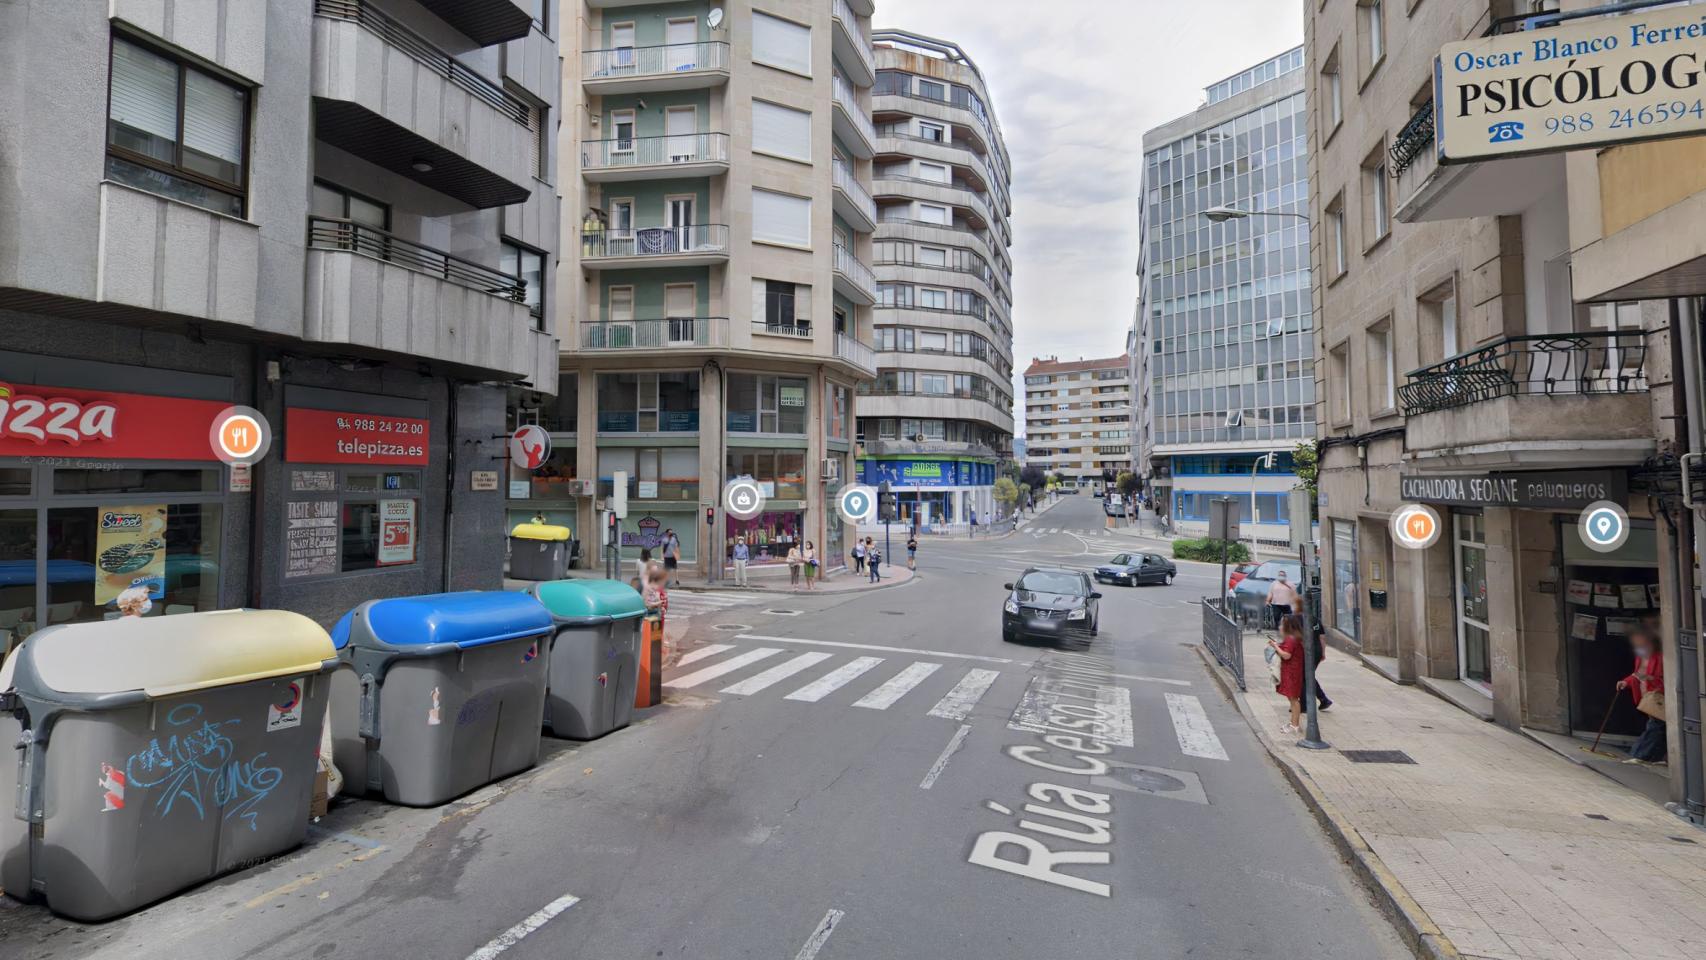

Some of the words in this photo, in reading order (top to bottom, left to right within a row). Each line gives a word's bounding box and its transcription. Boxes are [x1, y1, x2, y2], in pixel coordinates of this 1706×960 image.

[1454, 50, 1523, 72] Oscar
[1532, 35, 1618, 62] Blanco
[1456, 52, 1706, 118] PSICÓLOG
[1545, 113, 1594, 136] 988
[1609, 98, 1705, 129] 246594
[354, 419, 375, 431] 988
[379, 421, 392, 432] 24
[395, 422, 408, 433] 22
[411, 424, 423, 434] 00
[337, 438, 423, 458] telepizza.es
[1402, 478, 1466, 500] CACHALDORA
[1470, 478, 1519, 502] SEOANE
[1528, 481, 1606, 500] peluqueros
[101, 511, 142, 529] Sweet
